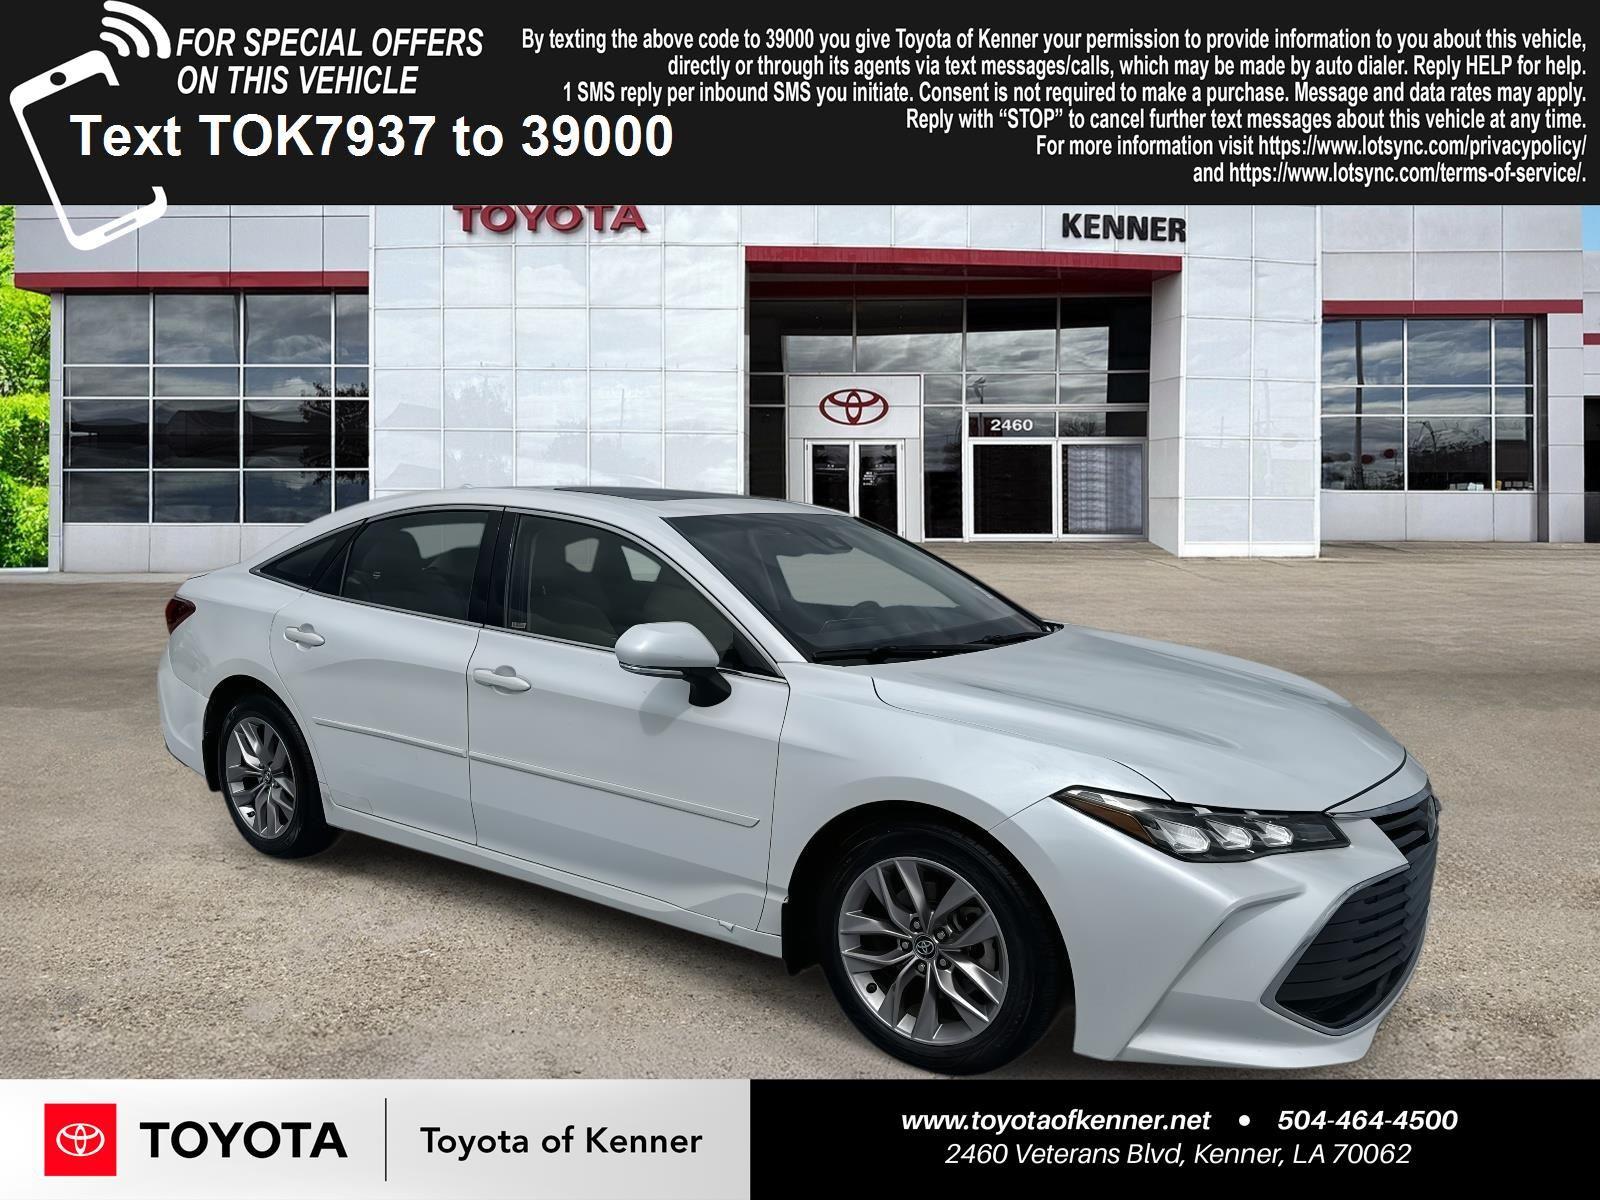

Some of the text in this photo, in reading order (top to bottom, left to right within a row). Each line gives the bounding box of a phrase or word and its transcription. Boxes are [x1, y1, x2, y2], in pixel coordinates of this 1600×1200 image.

[452, 205, 648, 233] TOYOTA
[1062, 212, 1187, 243] KENNER
[990, 419, 1033, 432] 2460
